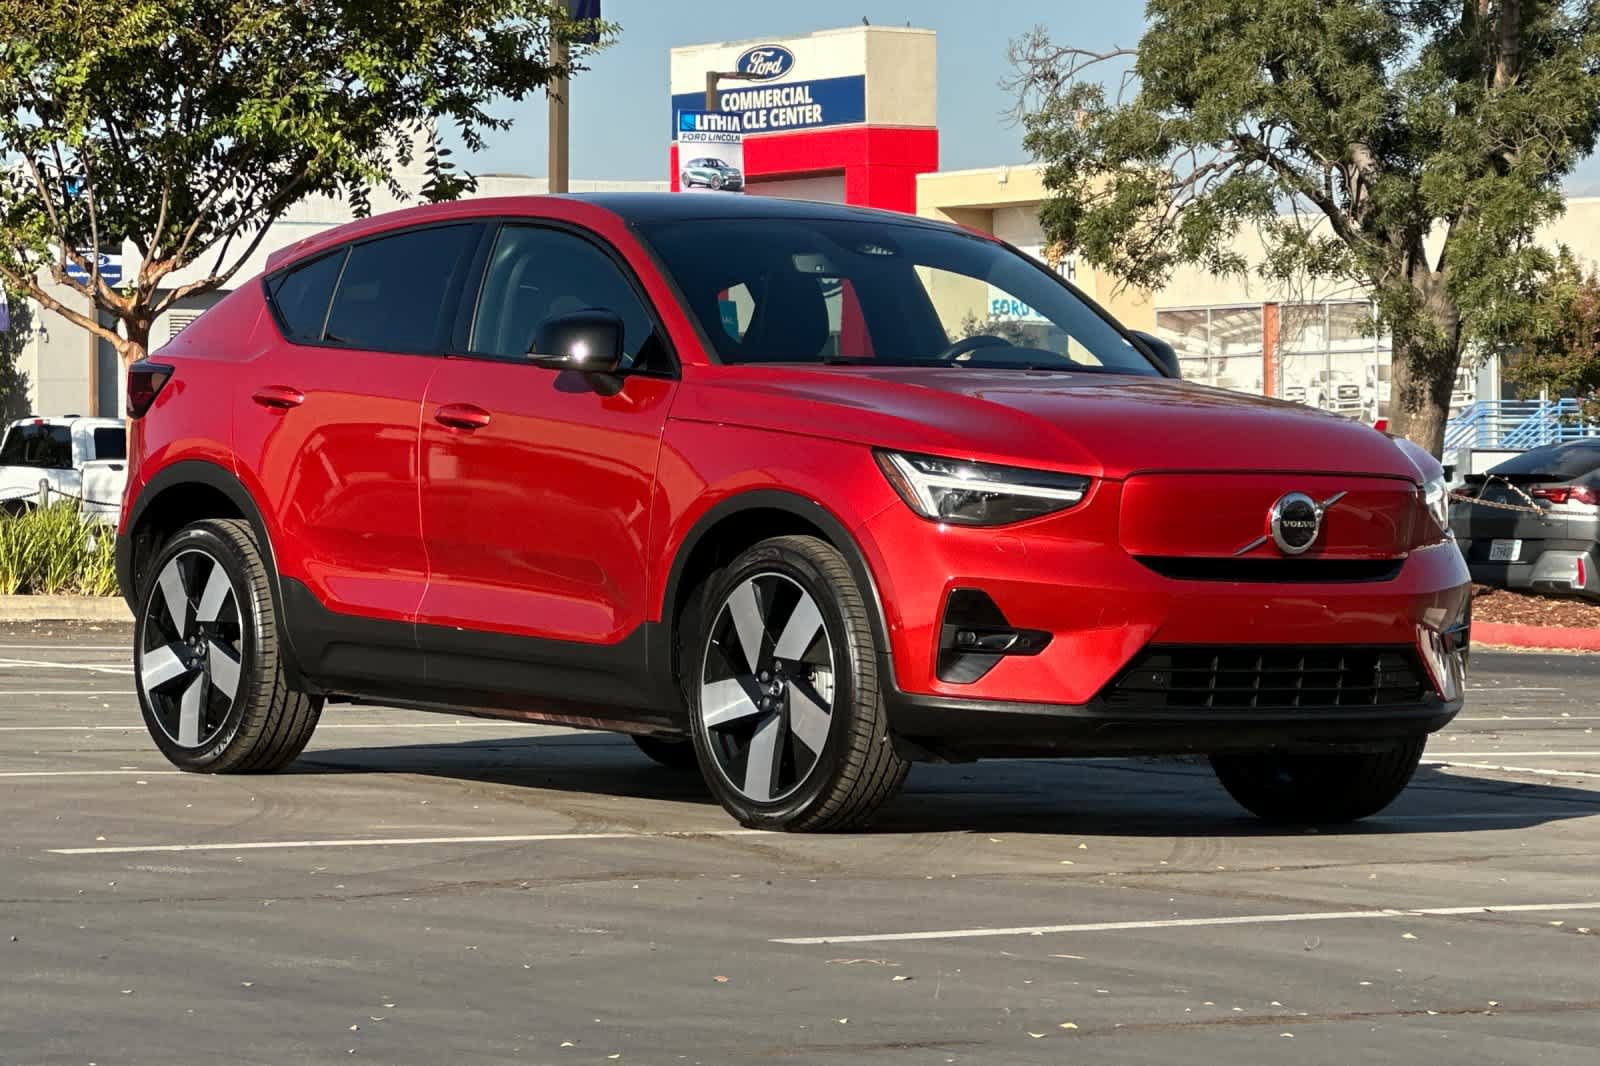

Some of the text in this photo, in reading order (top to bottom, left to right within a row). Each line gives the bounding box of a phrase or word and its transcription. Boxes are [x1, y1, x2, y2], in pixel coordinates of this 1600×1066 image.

[747, 51, 783, 75] Ford
[721, 86, 813, 112] COMMERCIAL
[695, 114, 740, 131] LITHIA
[770, 104, 822, 127] CENTER
[682, 133, 740, 142] FORD LINCOLN
[1283, 520, 1315, 528] VOLVO
